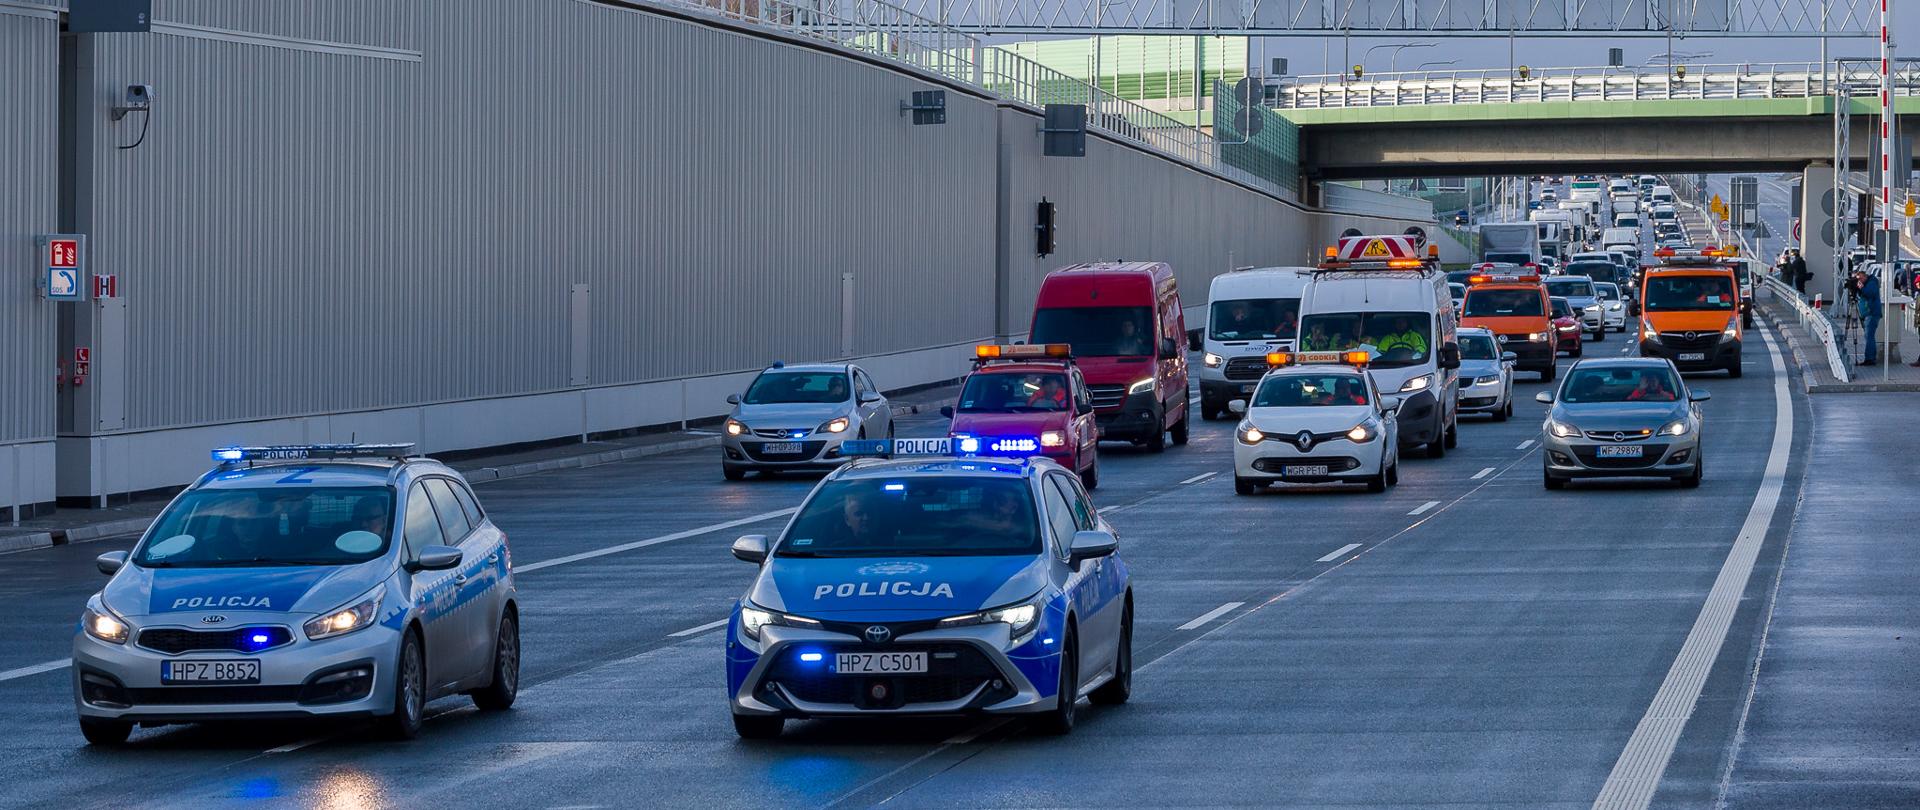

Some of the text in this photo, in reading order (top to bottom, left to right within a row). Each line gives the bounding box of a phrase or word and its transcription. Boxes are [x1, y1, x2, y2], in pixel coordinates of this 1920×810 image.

[100, 277, 109, 295] H
[896, 440, 948, 453] POLICJA
[1601, 446, 1641, 455] WF 2989K
[262, 450, 309, 459] POLICJA
[813, 581, 954, 600] POLICJA
[171, 596, 271, 609] POLICJA
[839, 654, 922, 672] HPZ C501
[173, 663, 257, 680] HPZ B852
